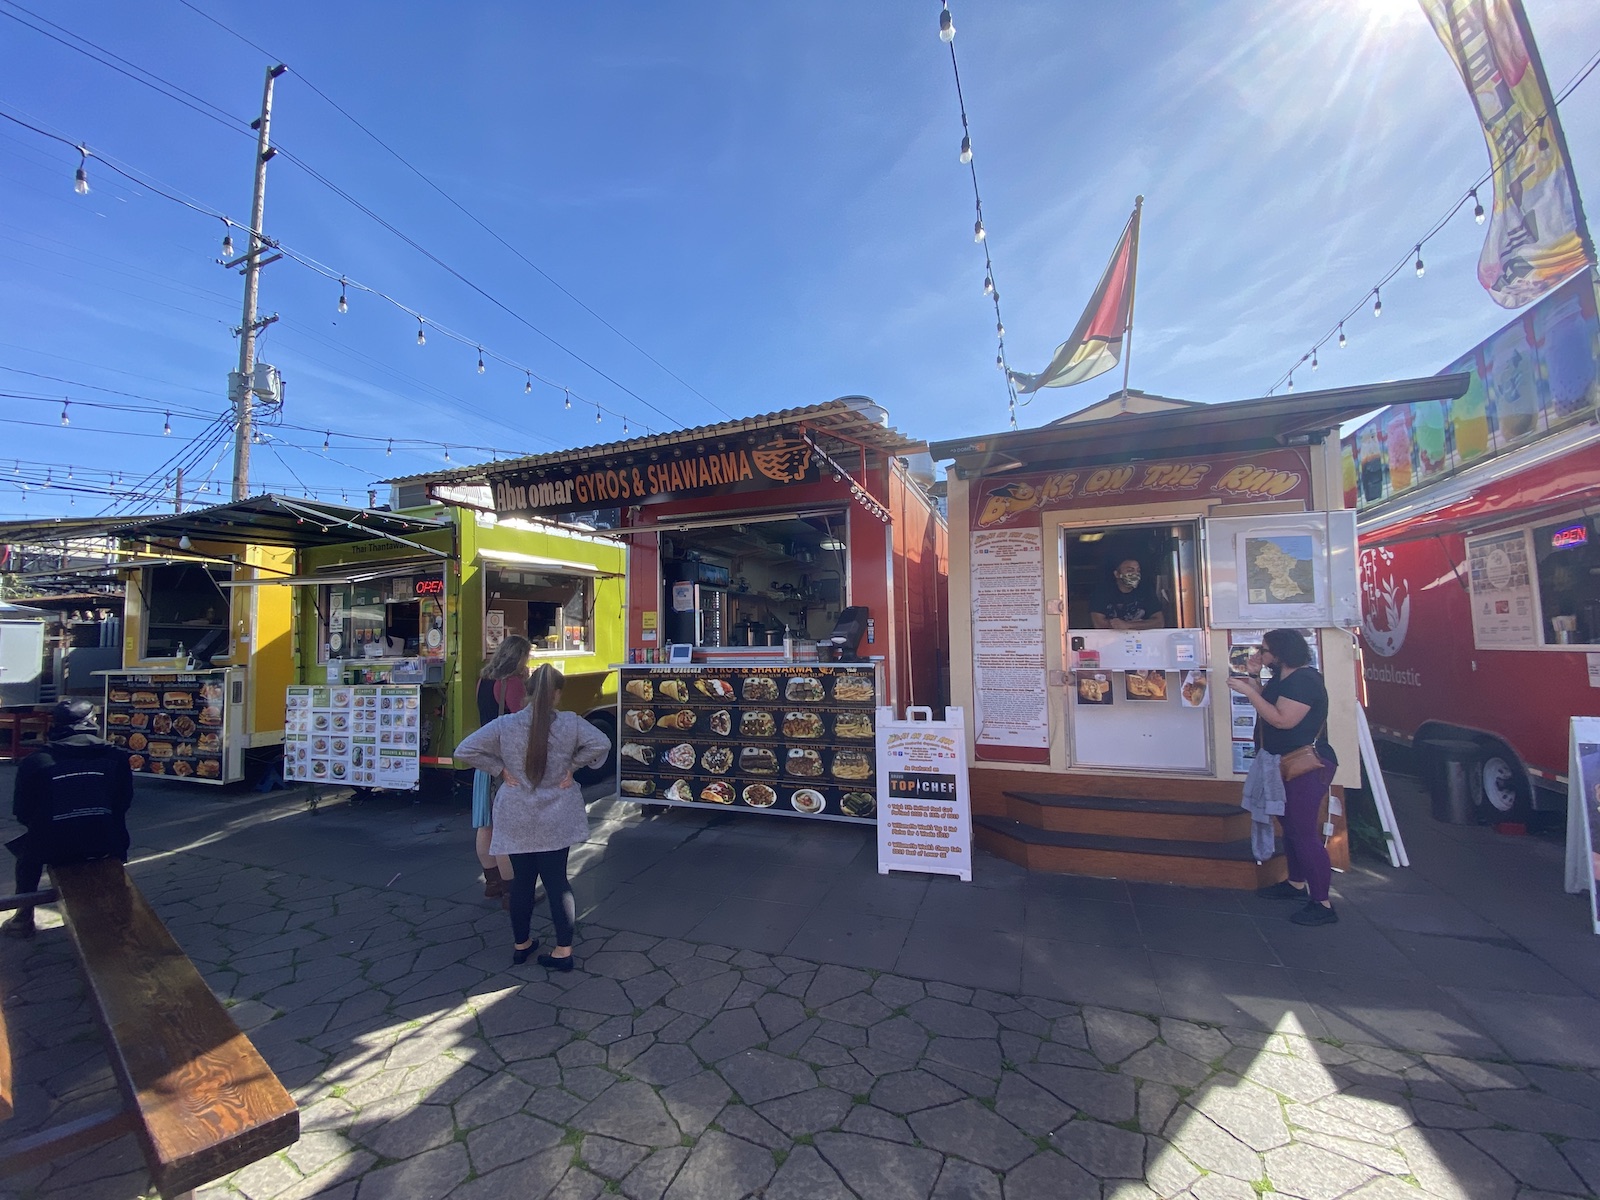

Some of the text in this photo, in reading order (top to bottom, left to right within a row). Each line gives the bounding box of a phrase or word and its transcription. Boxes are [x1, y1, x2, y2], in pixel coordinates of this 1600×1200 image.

[496, 450, 754, 512] Abu omar GYROS & SHAWARMA
[1082, 465, 1135, 495] ON
[1142, 463, 1211, 489] THE
[1214, 464, 1300, 499] RUN
[1554, 527, 1587, 546] OPEN
[352, 545, 367, 554] Thai
[416, 580, 444, 594] OPEN
[891, 780, 955, 793] TOP CHEF
